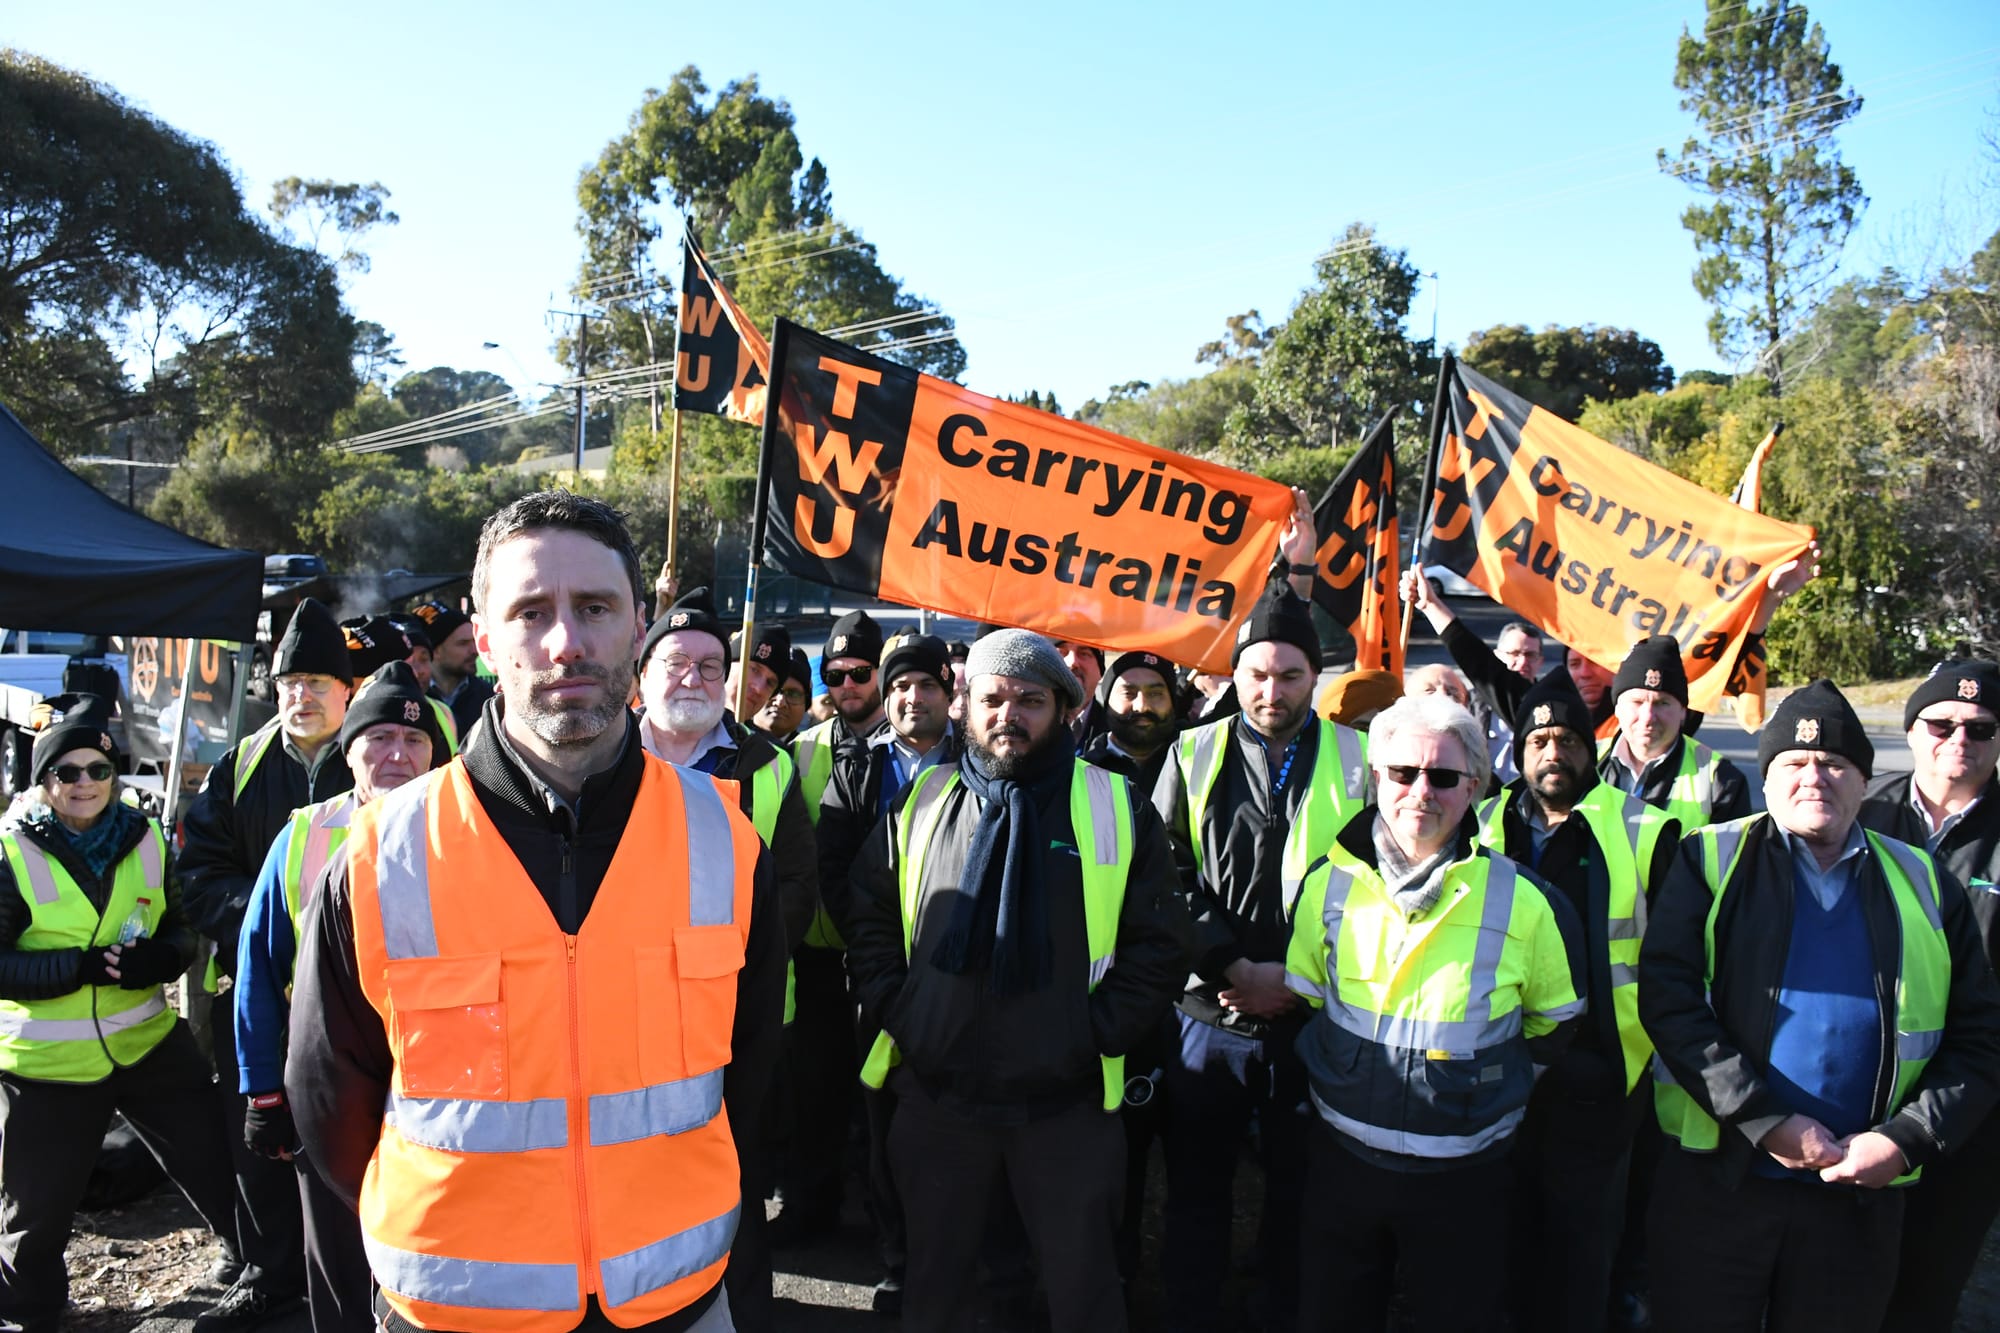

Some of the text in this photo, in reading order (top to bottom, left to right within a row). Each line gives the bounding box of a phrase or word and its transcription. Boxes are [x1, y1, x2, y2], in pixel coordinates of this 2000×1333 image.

[677, 265, 722, 392] WU
[794, 356, 885, 559] TWU
[937, 413, 1254, 546] Carrying
[911, 498, 1237, 621] Australia
[1494, 516, 1728, 662] Australia
[1529, 455, 1762, 602] Carrying
